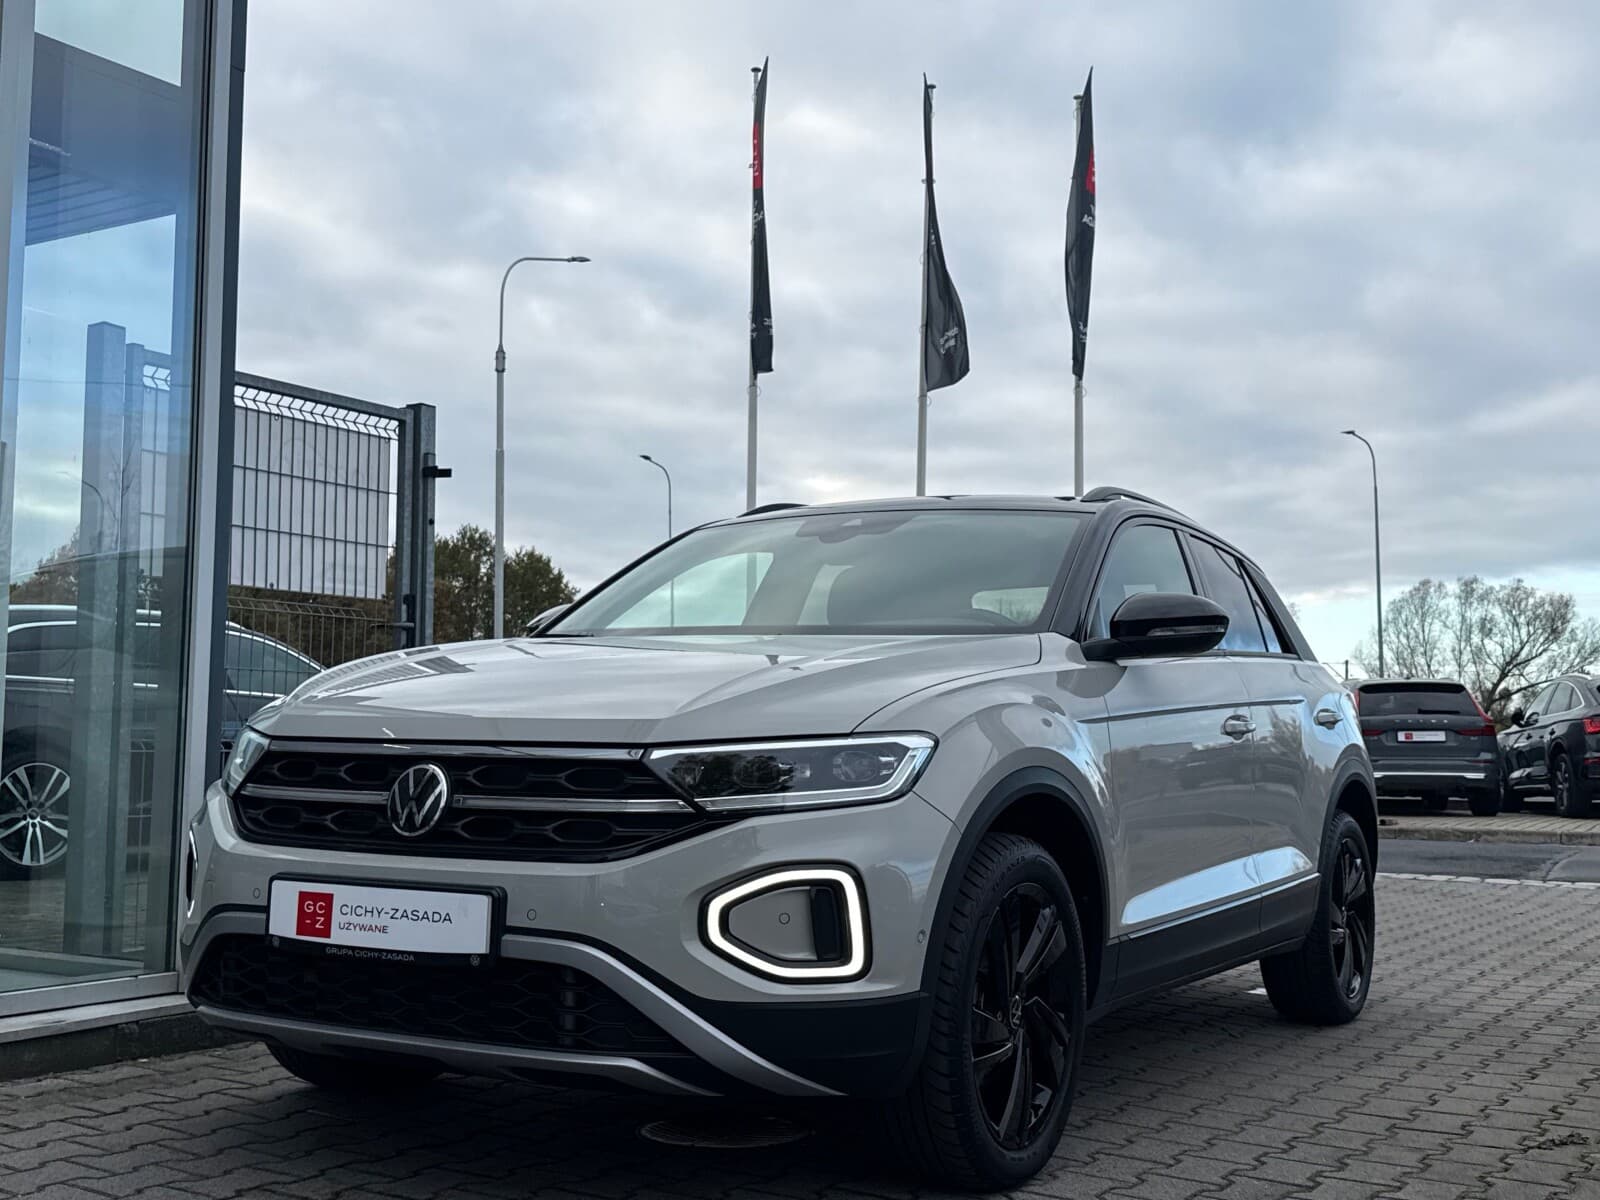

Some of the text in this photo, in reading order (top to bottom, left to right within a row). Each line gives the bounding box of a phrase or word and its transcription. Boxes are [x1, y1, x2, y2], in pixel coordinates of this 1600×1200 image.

[304, 900, 326, 914] GC
[339, 904, 453, 925] CICHY-ZASADA
[325, 946, 415, 961] GRUPA CICHY-ZASADA
